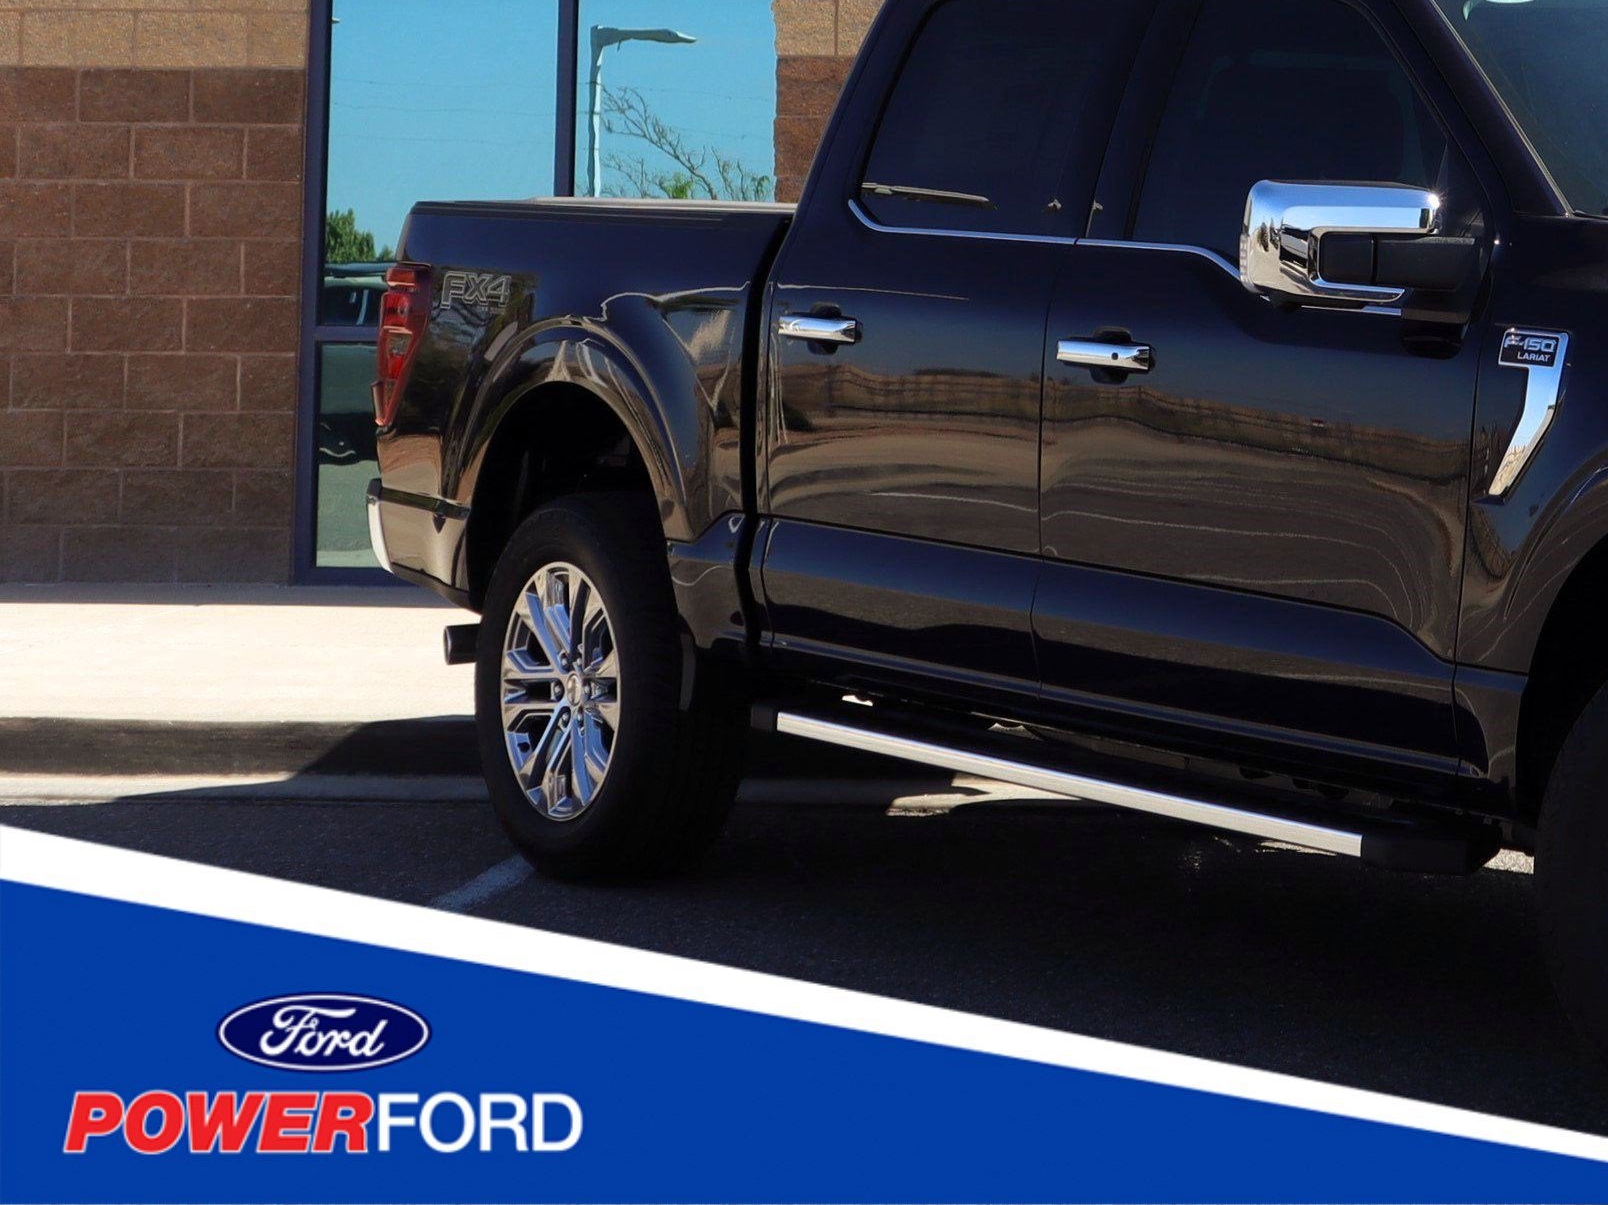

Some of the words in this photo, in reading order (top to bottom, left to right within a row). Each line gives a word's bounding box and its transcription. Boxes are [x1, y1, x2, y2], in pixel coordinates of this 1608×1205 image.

[440, 270, 511, 309] FX4
[1504, 335, 1557, 352] F-150
[1517, 351, 1551, 362] LARIAT
